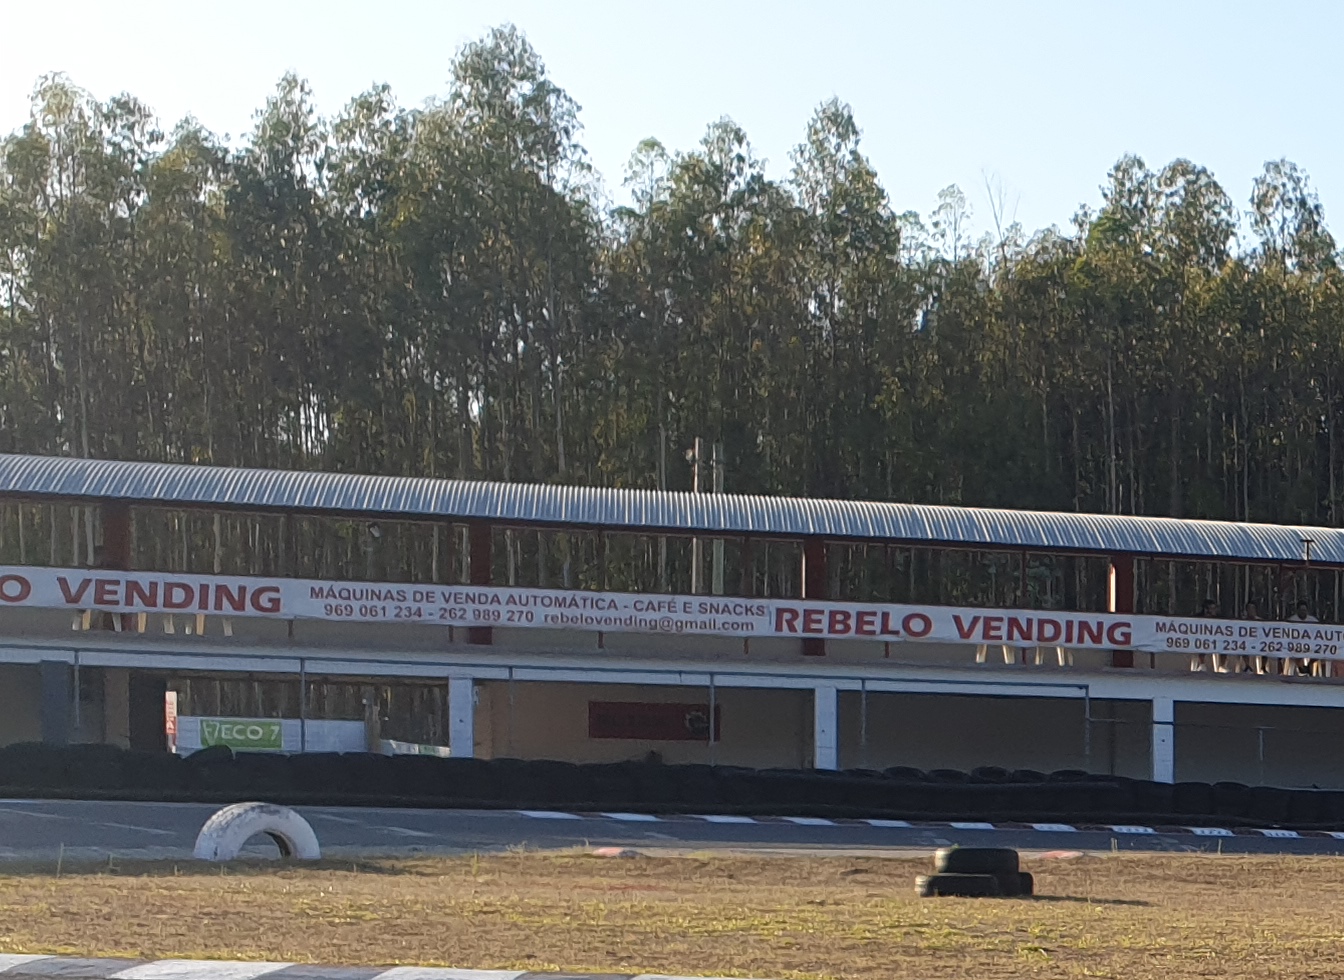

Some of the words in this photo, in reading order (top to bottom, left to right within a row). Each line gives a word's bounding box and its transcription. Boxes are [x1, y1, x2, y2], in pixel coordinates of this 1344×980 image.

[57, 576, 281, 613] VENDING
[310, 585, 407, 603] MÁQUINAS
[412, 590, 435, 603] DE
[441, 591, 501, 605] VENDA
[505, 593, 619, 611] AUTOMÁTICA
[633, 598, 677, 614] CAFÉ
[683, 601, 692, 614] E
[698, 601, 765, 617] SNACKS
[324, 603, 353, 617] 969
[359, 605, 387, 618] 061
[394, 606, 422, 619] 234
[439, 607, 467, 620] 262
[473, 608, 501, 622] 989
[507, 610, 534, 623] 270
[544, 611, 754, 633] rebelovending@gmail.com
[775, 607, 932, 638] REBELO
[952, 614, 1132, 646] VENDING
[1155, 620, 1233, 637] MÁQUINAS
[1238, 626, 1258, 638] DE
[1262, 627, 1312, 640] VENDA
[1166, 637, 1190, 649] 969
[1194, 638, 1217, 650] 061
[1222, 639, 1247, 651] 234
[1259, 640, 1283, 653] 262
[1287, 641, 1311, 654] 989
[1314, 642, 1337, 655] 270
[221, 724, 263, 740] ECO
